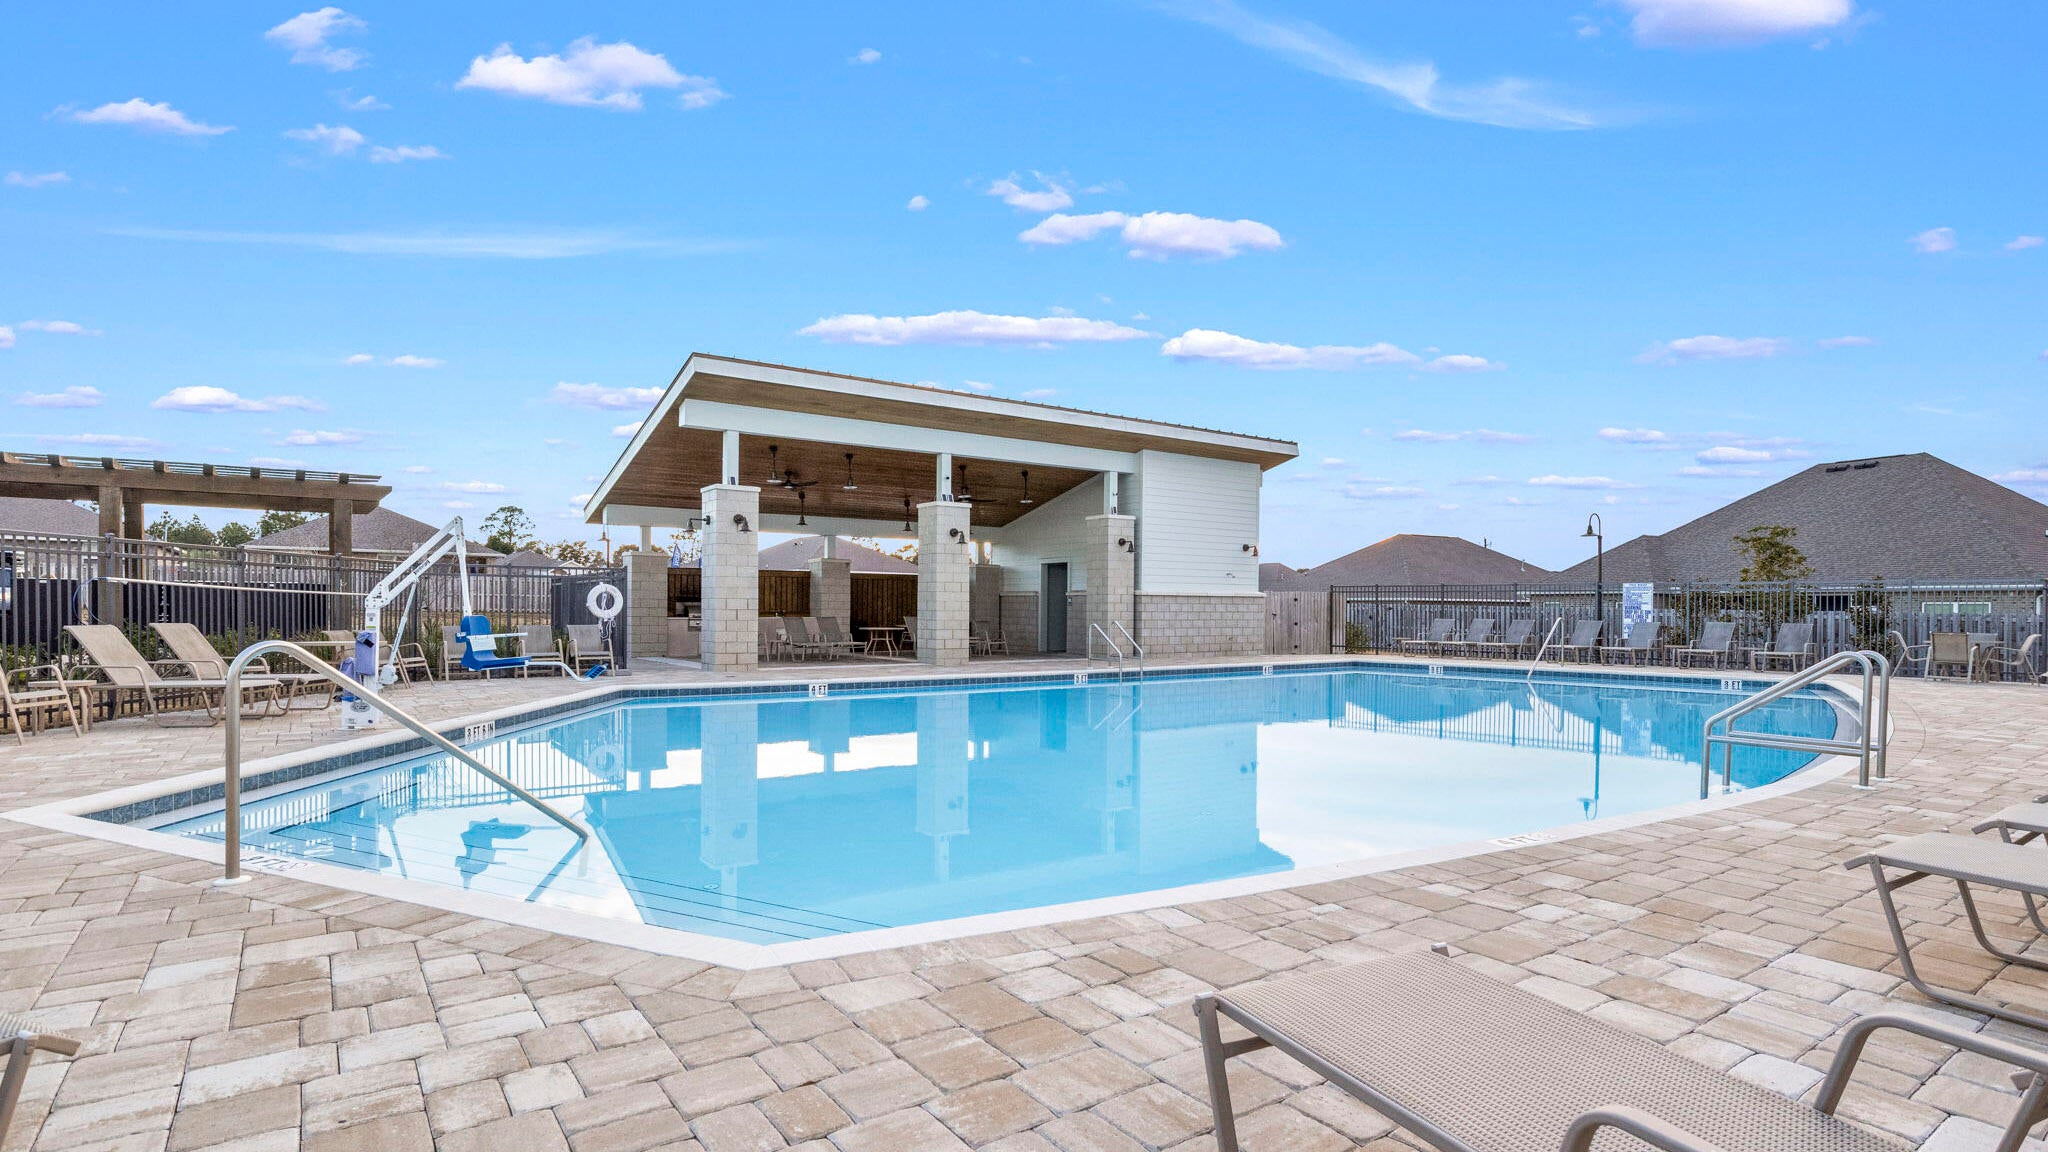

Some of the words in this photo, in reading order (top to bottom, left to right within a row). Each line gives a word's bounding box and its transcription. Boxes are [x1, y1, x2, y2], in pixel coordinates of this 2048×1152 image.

[818, 685, 827, 695] FT
[1724, 680, 1729, 690] 3
[1731, 680, 1740, 690] FT
[473, 725, 481, 736] FT
[487, 722, 494, 733] IN
